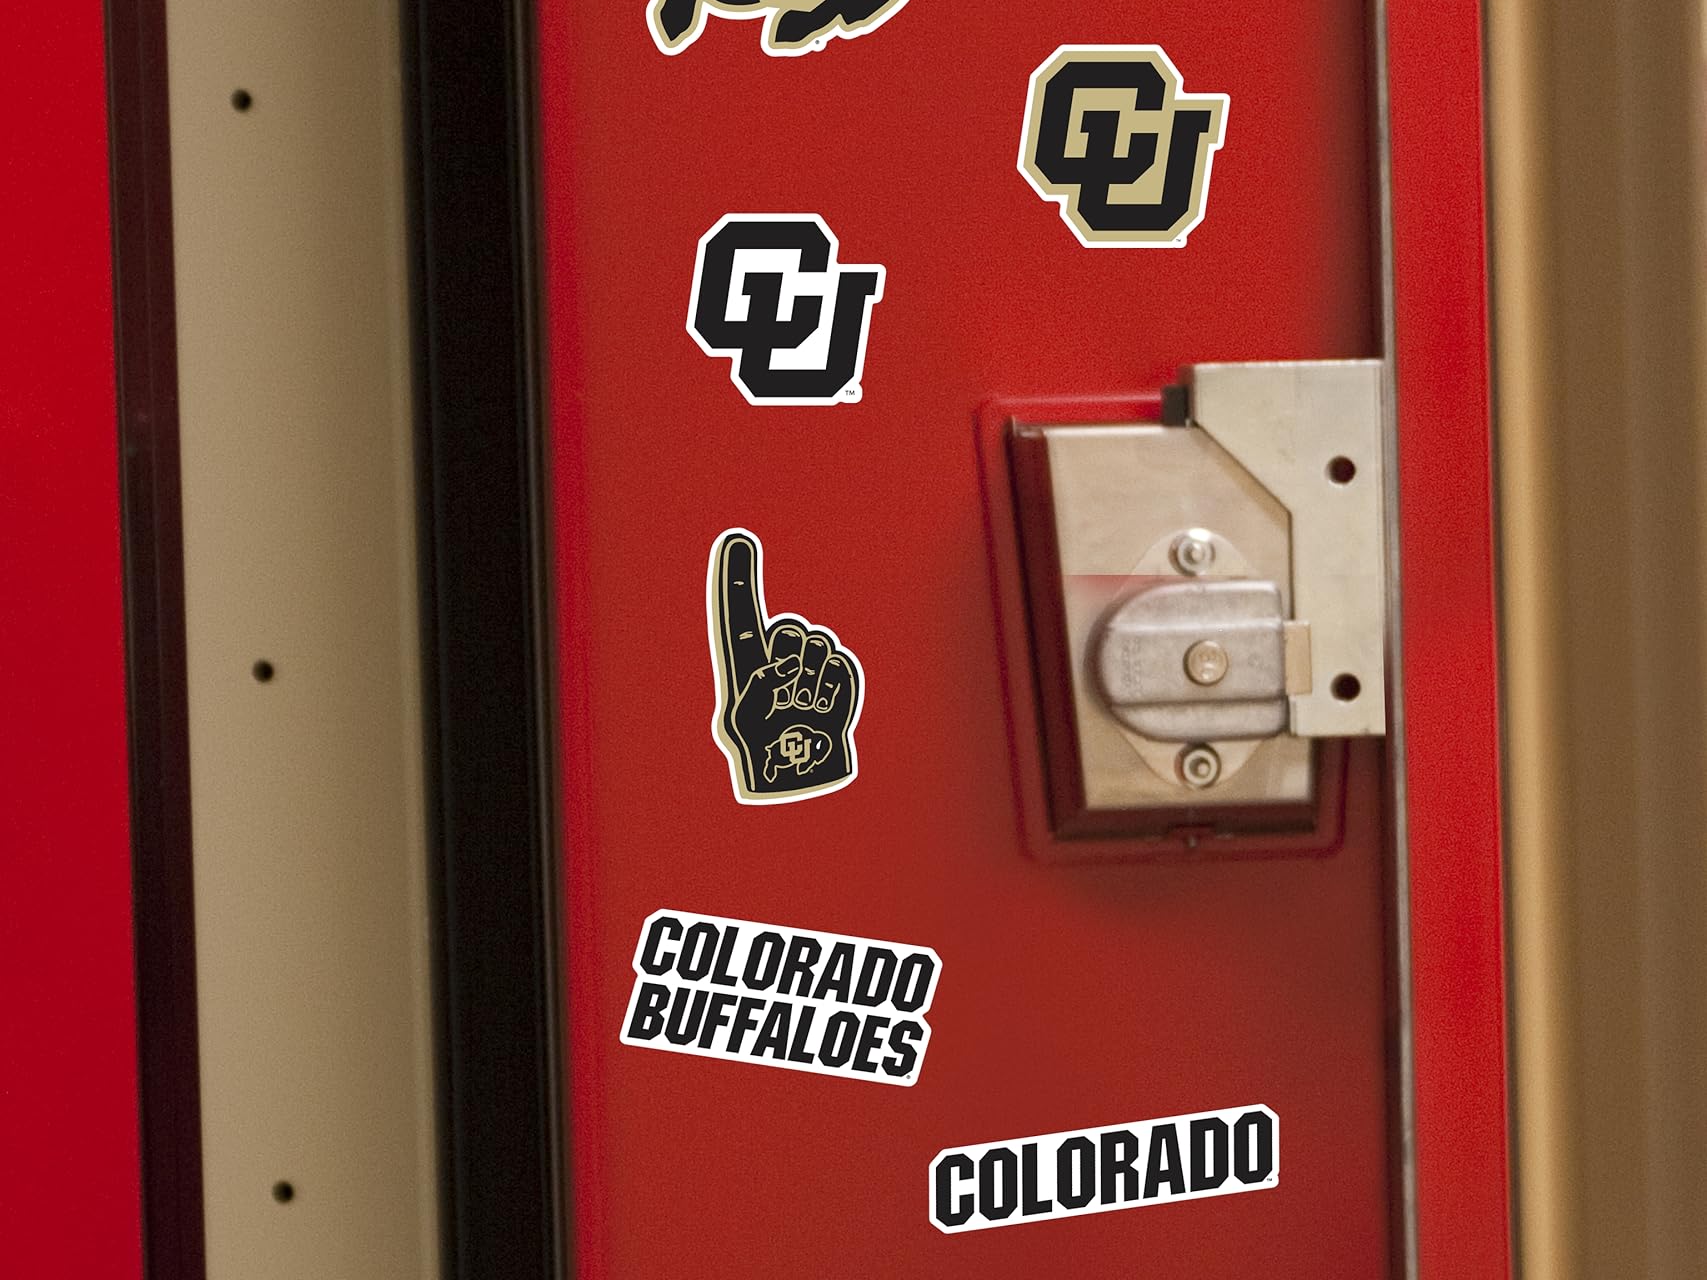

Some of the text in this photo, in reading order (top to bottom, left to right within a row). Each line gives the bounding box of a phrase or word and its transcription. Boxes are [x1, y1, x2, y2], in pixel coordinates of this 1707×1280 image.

[1034, 61, 1212, 231] CU
[694, 221, 879, 398] CU
[780, 731, 812, 765] CU
[640, 916, 935, 1012] COLORADO
[627, 982, 924, 1077] BUFFALOES
[936, 1110, 1272, 1227] COLORADO
